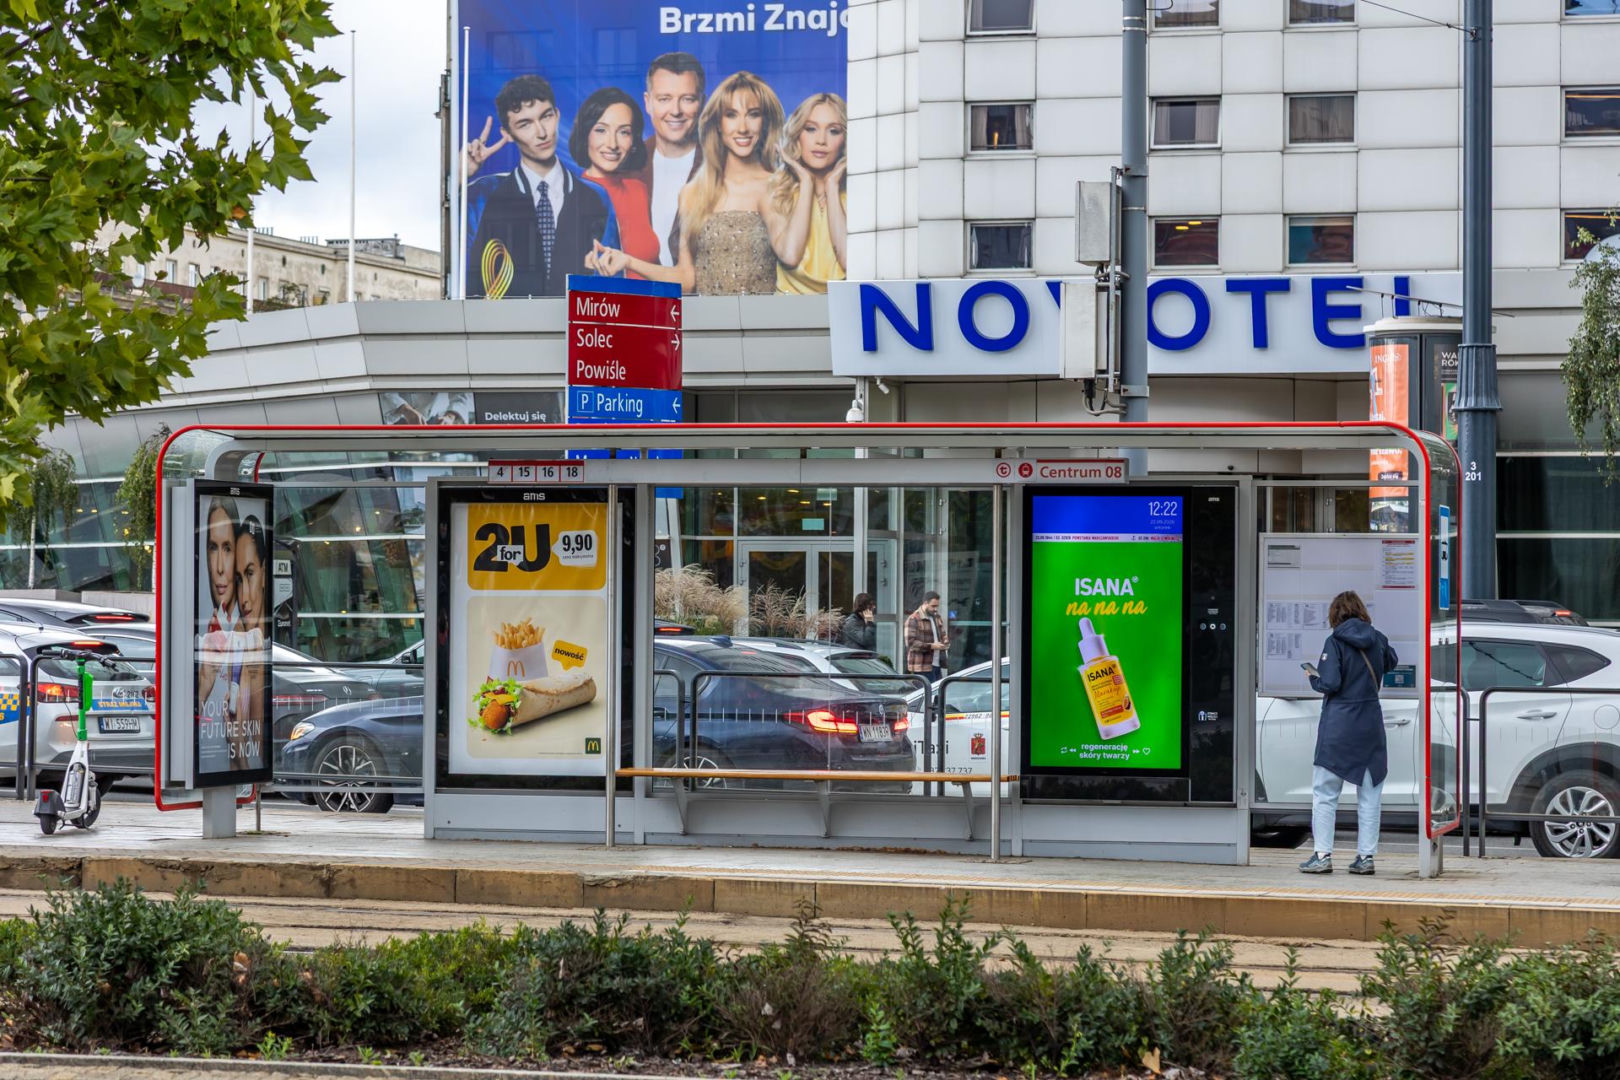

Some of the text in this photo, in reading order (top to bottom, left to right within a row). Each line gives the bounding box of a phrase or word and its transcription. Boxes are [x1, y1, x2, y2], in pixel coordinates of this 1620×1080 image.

[660, 4, 755, 34] Brzmi
[577, 297, 621, 318] Mirów
[860, 275, 1410, 353] NOOTE
[577, 328, 614, 348] Solec
[577, 360, 626, 380] Powiśle
[597, 393, 643, 418] Parking
[485, 411, 546, 423] Delektuj się
[496, 466, 578, 478] 4 15 16 18
[1040, 466, 1122, 478] Centrum 08
[1470, 461, 1477, 470] 3
[1465, 472, 1482, 481] 201
[523, 492, 546, 501] ams
[1148, 501, 1178, 516] 12:22
[562, 534, 593, 555] 9,90
[500, 546, 521, 562] for
[1066, 600, 1148, 615] na na na
[555, 647, 585, 661] nowość
[201, 700, 229, 717] YOUR
[201, 720, 261, 739] FUTURE SKIN
[227, 743, 236, 759] IS
[239, 741, 260, 758] NOW
[1079, 751, 1130, 760] skóry twarzy
[1081, 743, 1128, 753] regenerację
